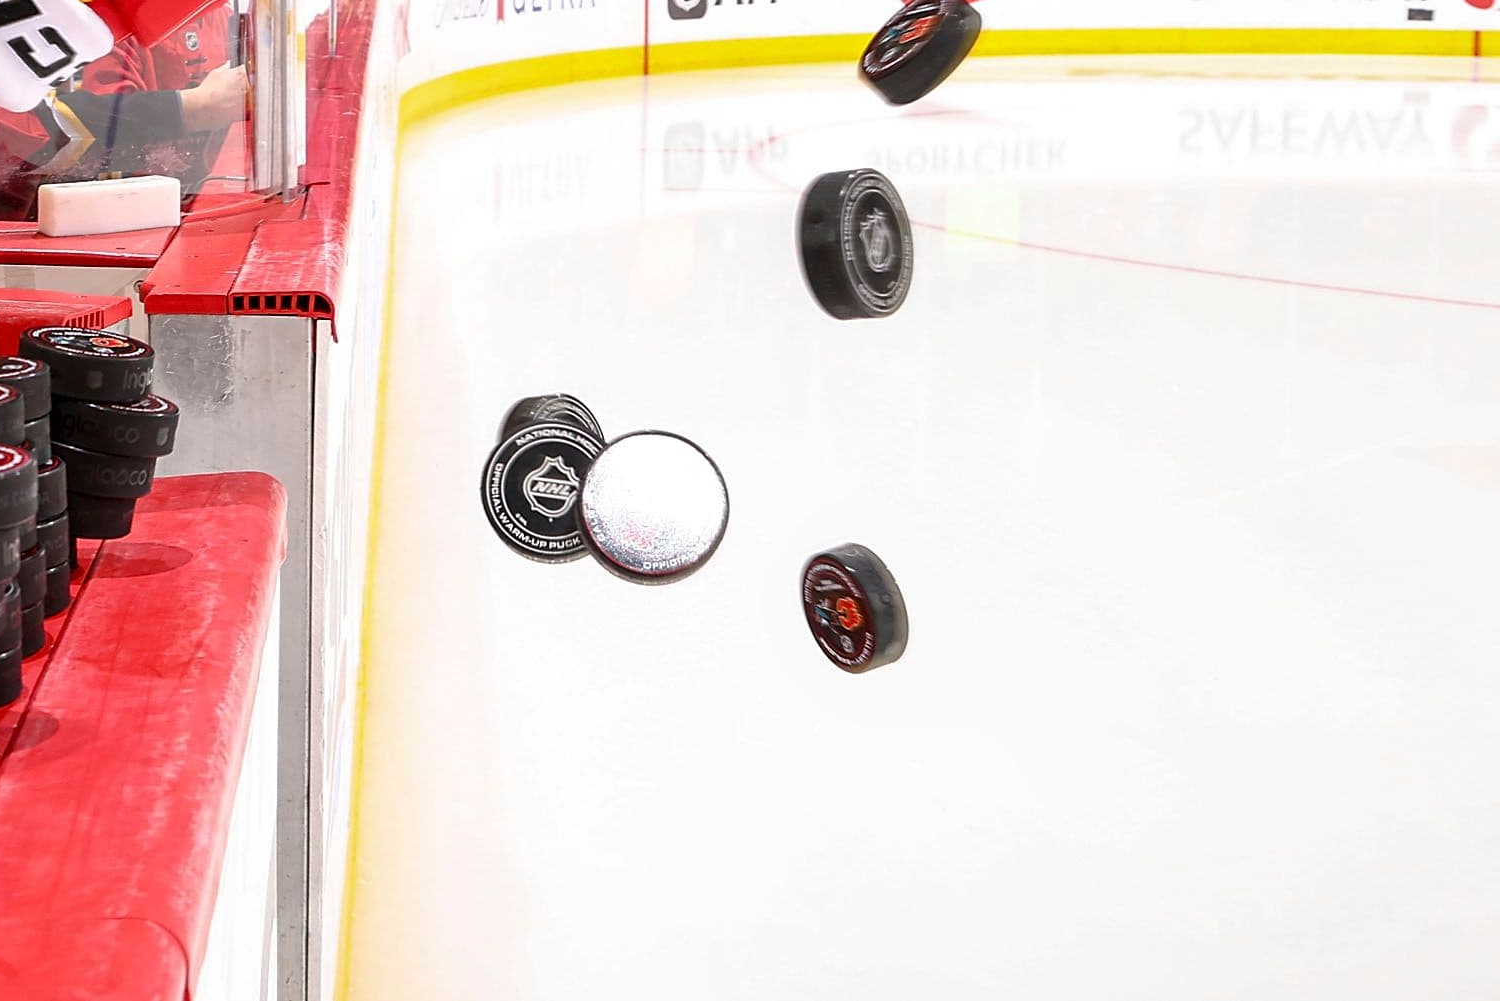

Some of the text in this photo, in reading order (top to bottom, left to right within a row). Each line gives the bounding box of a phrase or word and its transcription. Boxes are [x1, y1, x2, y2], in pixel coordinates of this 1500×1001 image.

[515, 428, 576, 447] NATIONAL
[531, 480, 572, 496] NHL
[491, 462, 504, 514] OFFICIAL
[499, 512, 547, 550] WARM-UP
[548, 537, 582, 550] PUCK
